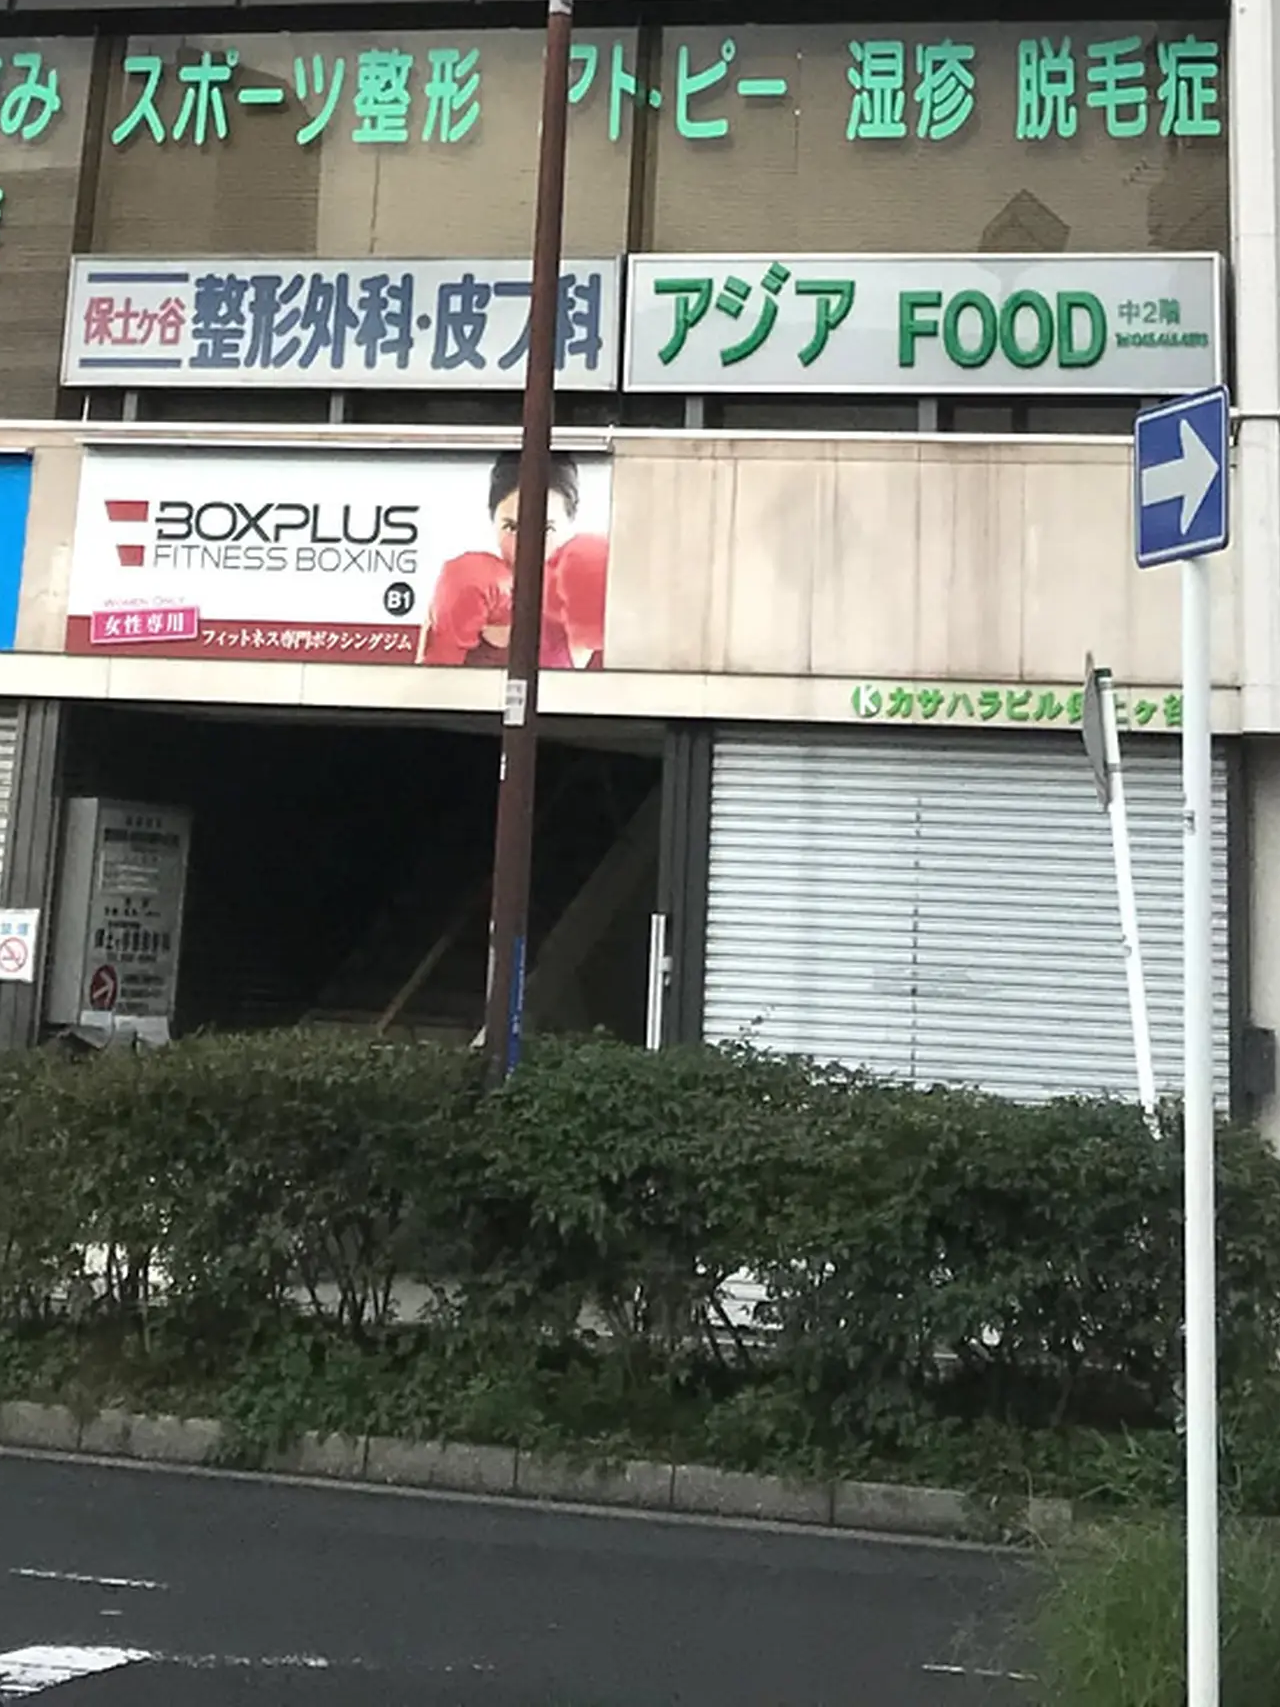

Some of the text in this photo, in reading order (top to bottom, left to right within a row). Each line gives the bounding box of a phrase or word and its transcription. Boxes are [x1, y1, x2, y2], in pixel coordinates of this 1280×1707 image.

[110, 45, 482, 147] スポーツ整形
[1014, 33, 1222, 141] 脱毛症
[652, 259, 1109, 370] アジア FOOD
[153, 543, 418, 574] FITNESS BOXING
[154, 500, 420, 545] BOXPLUS
[387, 590, 412, 610] B1
